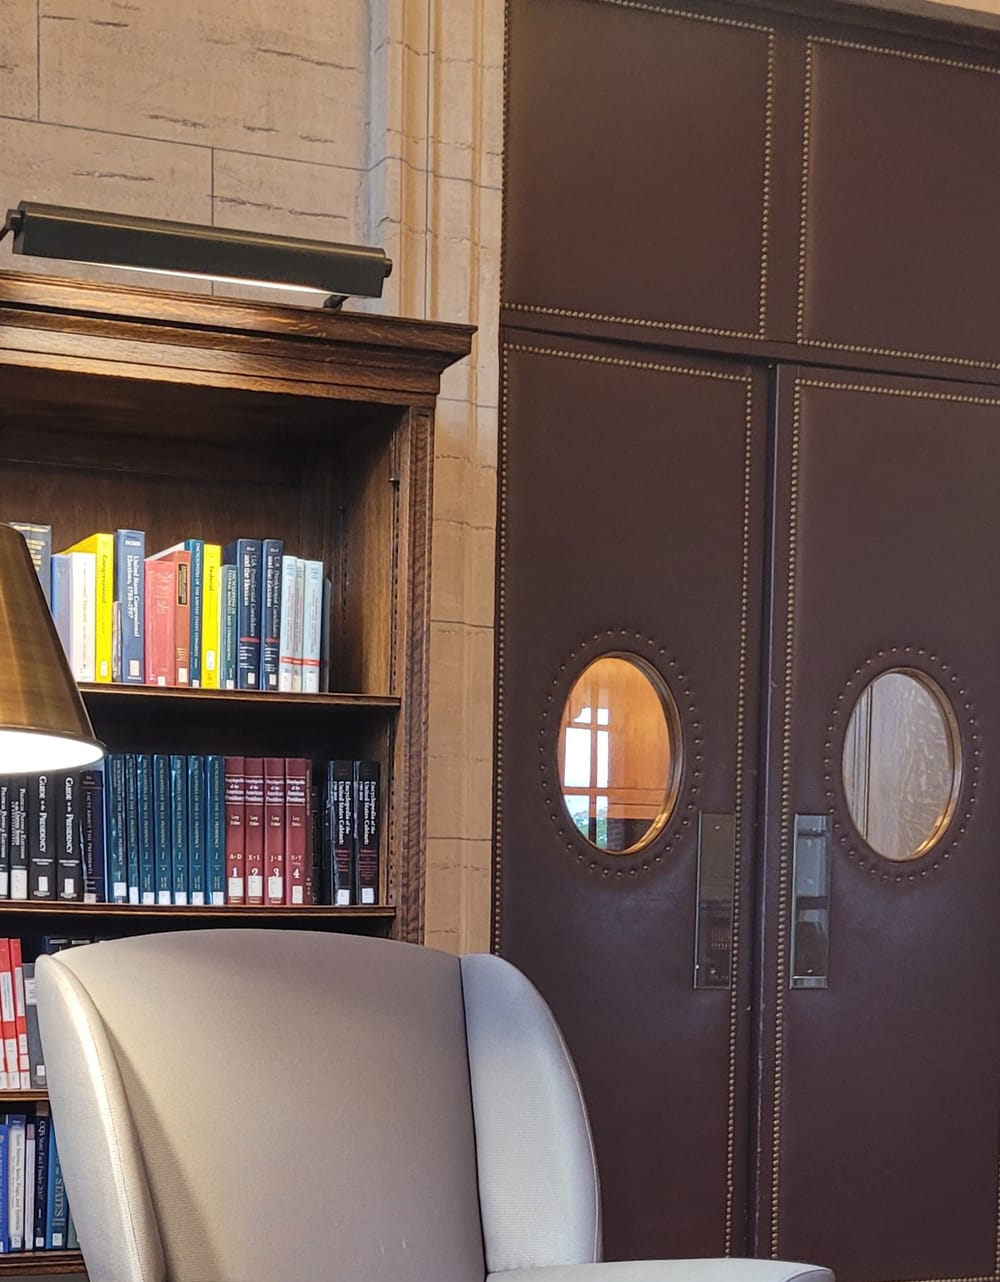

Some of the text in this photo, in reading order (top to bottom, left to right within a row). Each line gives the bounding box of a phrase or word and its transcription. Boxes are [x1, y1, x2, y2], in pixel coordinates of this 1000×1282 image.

[100, 554, 108, 604] Congressional
[132, 555, 141, 577] United
[130, 595, 141, 637] Congressional
[39, 775, 47, 853] GUIDE PRESIDENCY
[65, 777, 74, 854] GUIDE PRESIDENCY
[292, 868, 301, 879] 4
[55, 1177, 65, 1217] STATES
